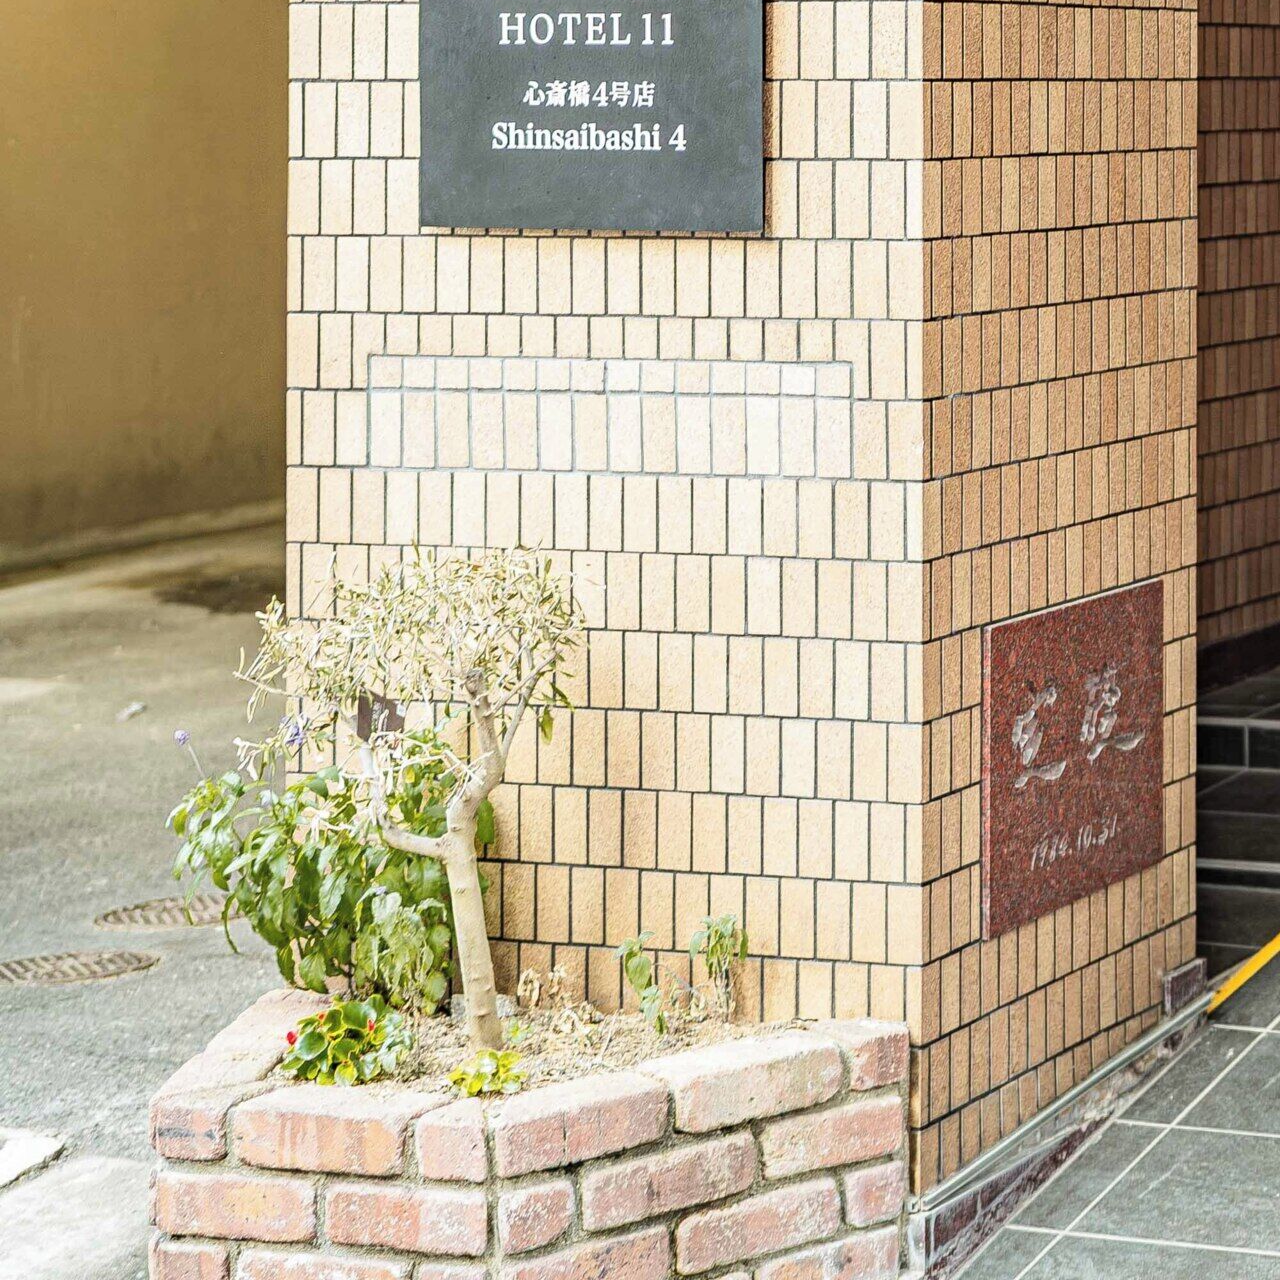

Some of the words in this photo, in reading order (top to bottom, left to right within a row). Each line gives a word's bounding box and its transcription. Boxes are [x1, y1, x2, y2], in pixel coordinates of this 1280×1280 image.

[499, 13, 631, 44] HOTEL
[642, 13, 674, 45] 11
[523, 80, 655, 107] 心斎橋4号店
[492, 122, 661, 150] Shinsaibashi
[669, 125, 686, 151] 4
